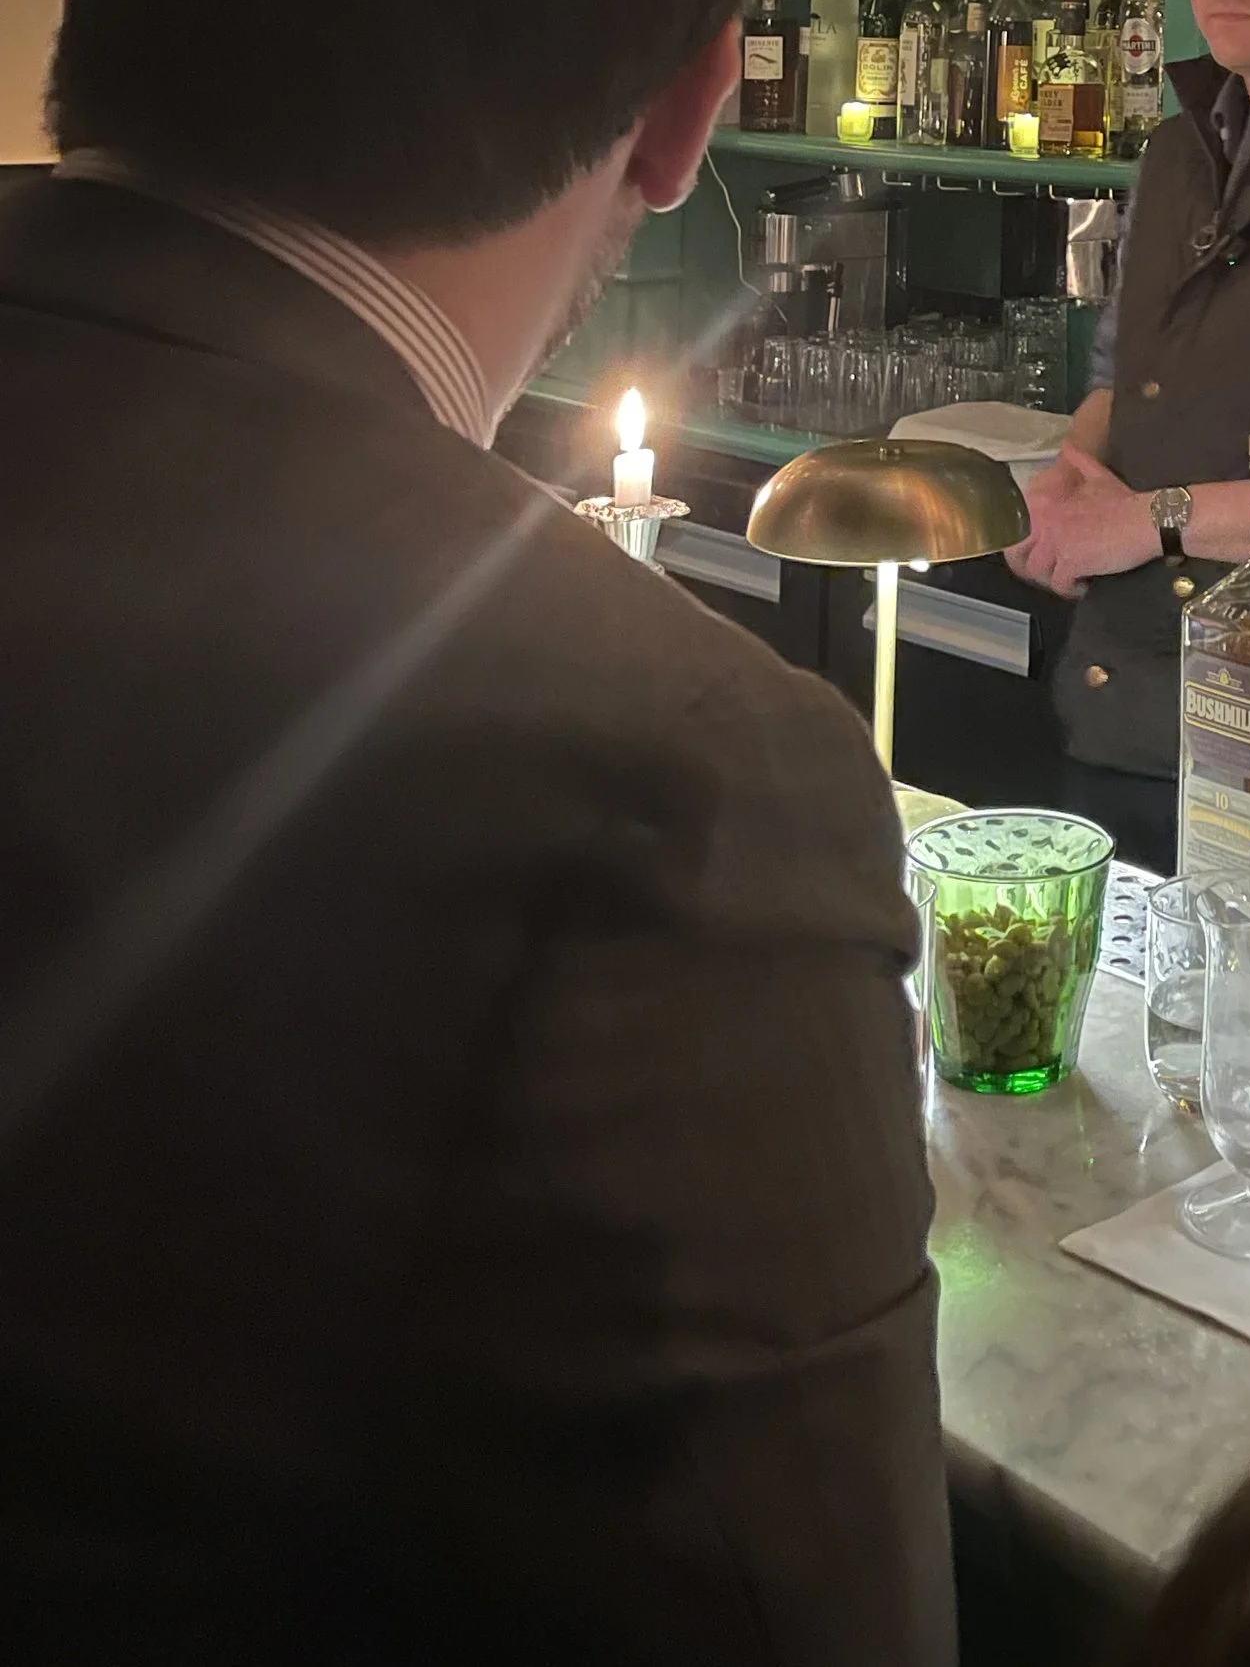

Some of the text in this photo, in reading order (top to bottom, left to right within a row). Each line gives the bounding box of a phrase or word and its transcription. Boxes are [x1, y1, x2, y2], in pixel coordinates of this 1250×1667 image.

[1122, 41, 1156, 51] MARTINI
[862, 63, 893, 71] DOLIN
[1214, 791, 1229, 811] 10
